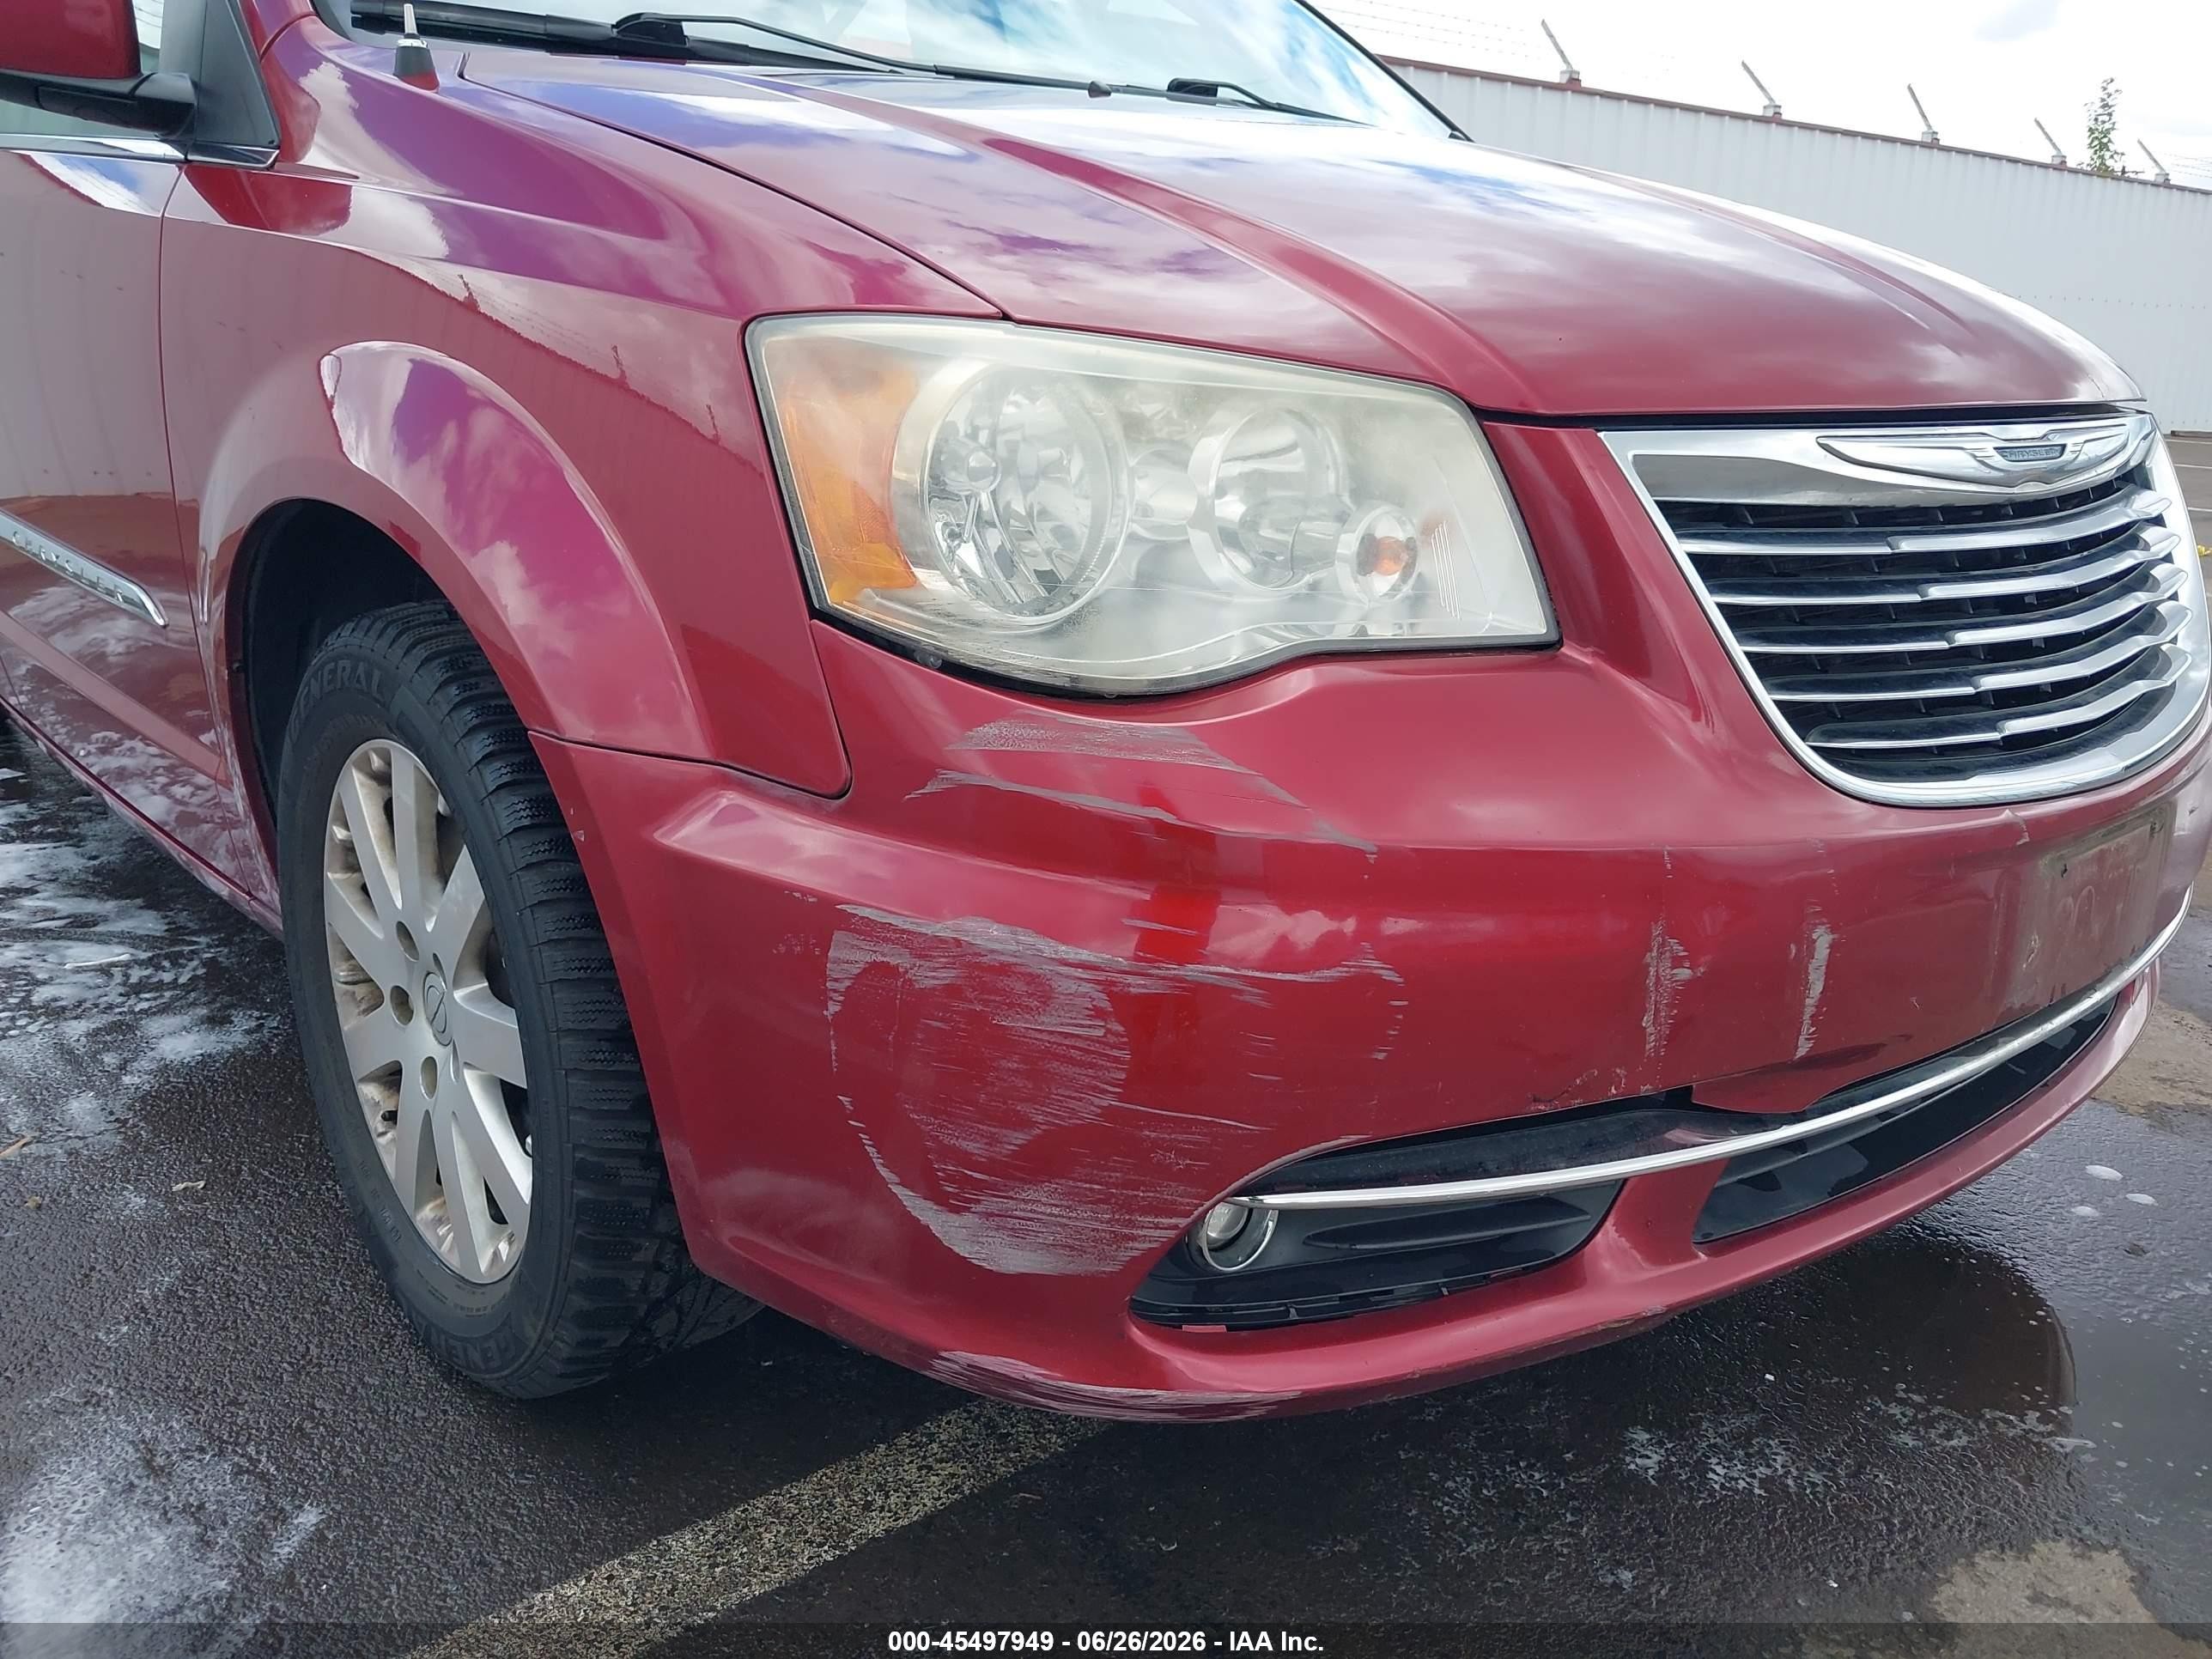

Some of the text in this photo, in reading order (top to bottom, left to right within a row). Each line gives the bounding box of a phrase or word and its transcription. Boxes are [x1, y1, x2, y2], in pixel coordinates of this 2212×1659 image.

[1999, 446, 2060, 460] CHRYSLER
[12, 530, 125, 603] CHRYSLER
[289, 659, 389, 744] GENERAL
